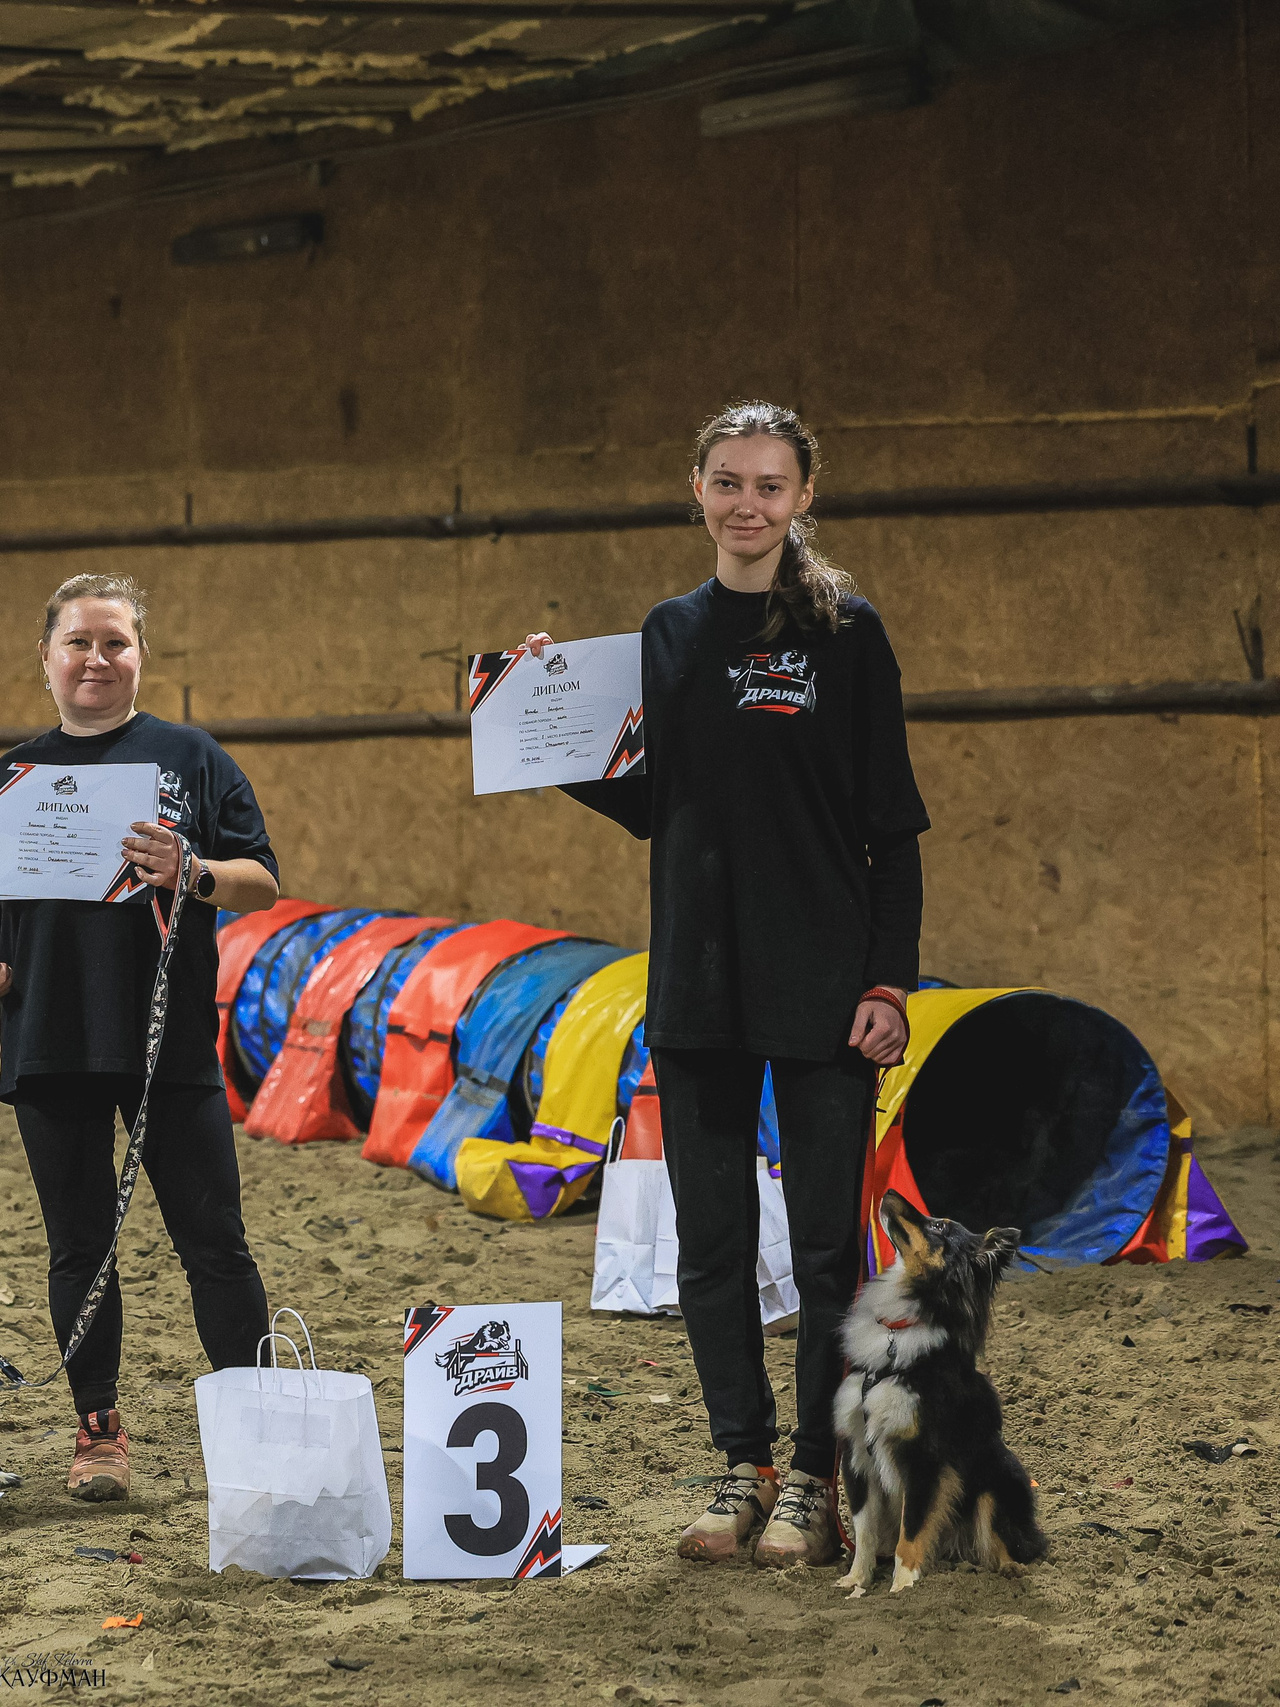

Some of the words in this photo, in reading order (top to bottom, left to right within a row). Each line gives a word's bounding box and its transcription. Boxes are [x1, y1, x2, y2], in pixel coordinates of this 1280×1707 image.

[532, 680, 580, 698] ДИПЛОМ
[36, 801, 89, 814] ДИПЛОМ
[443, 1402, 530, 1556] 3
